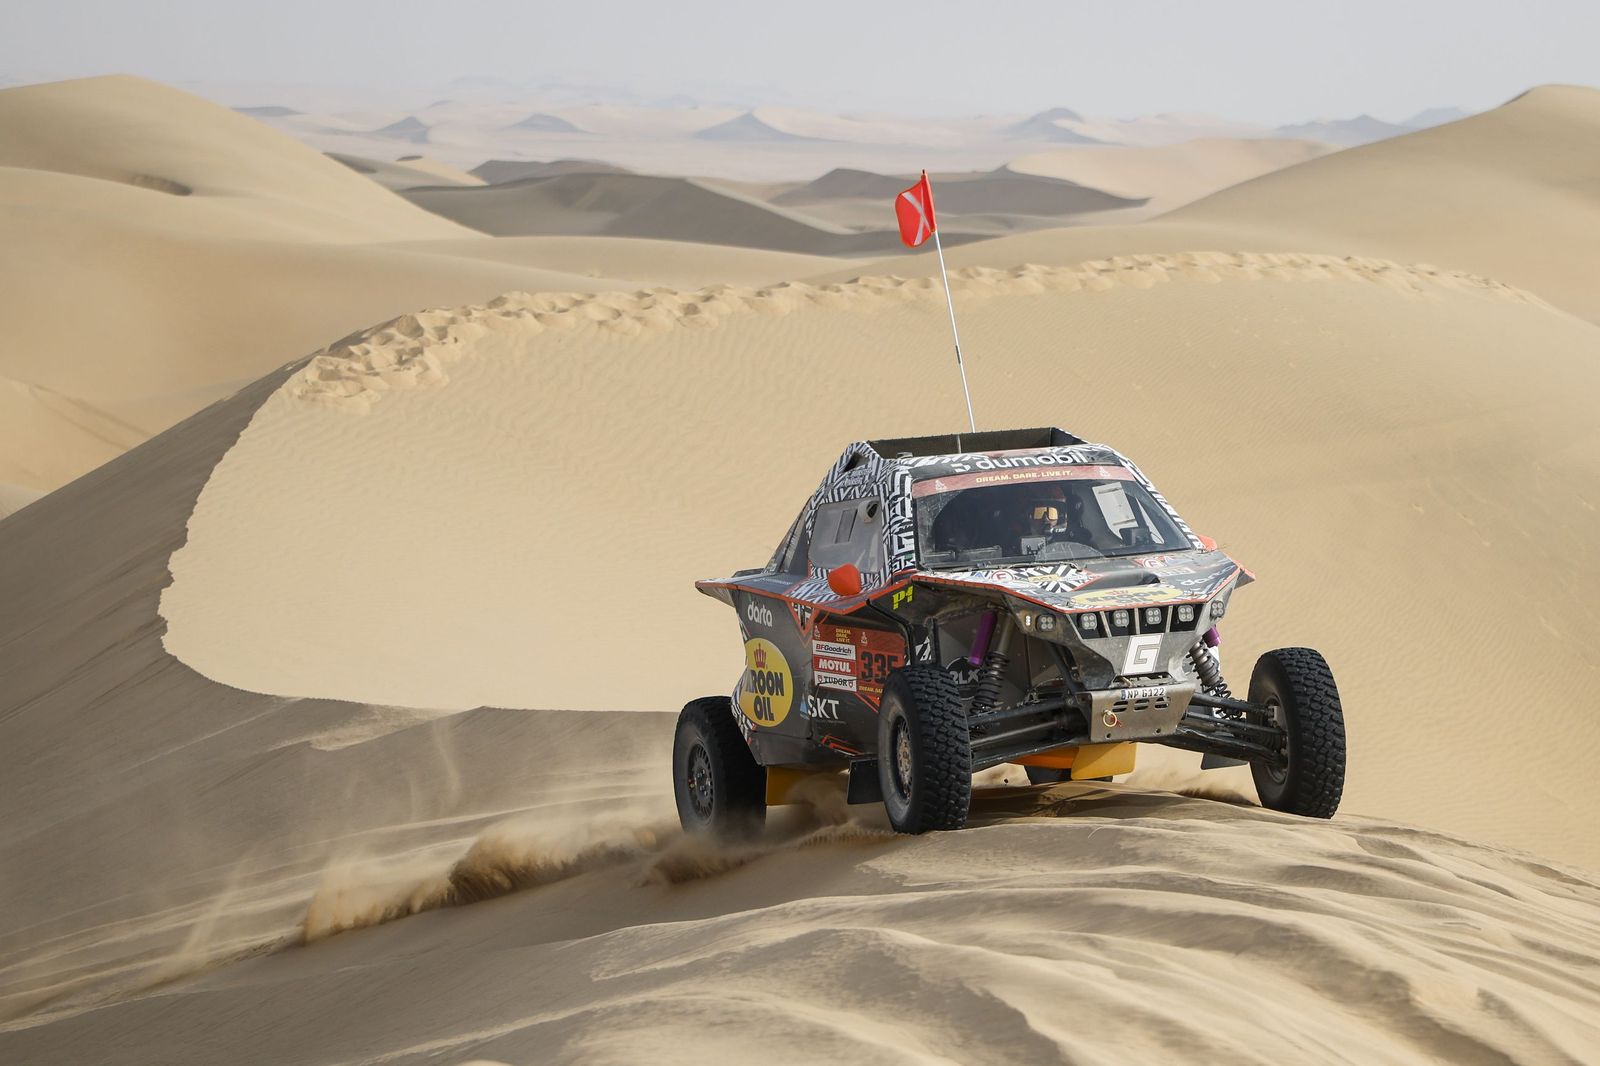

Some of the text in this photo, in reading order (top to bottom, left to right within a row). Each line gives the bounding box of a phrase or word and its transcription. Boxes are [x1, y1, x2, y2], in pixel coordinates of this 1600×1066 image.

[975, 450, 1088, 470] dumobil
[975, 475, 1011, 483] DREAM.
[747, 601, 773, 628] darta
[815, 644, 852, 654] BFGoodrich
[818, 658, 851, 673] MOTUL
[823, 676, 847, 687] TUDOR
[1127, 690, 1139, 699] NP
[753, 695, 775, 721] OIL
[807, 694, 840, 720] SKT
